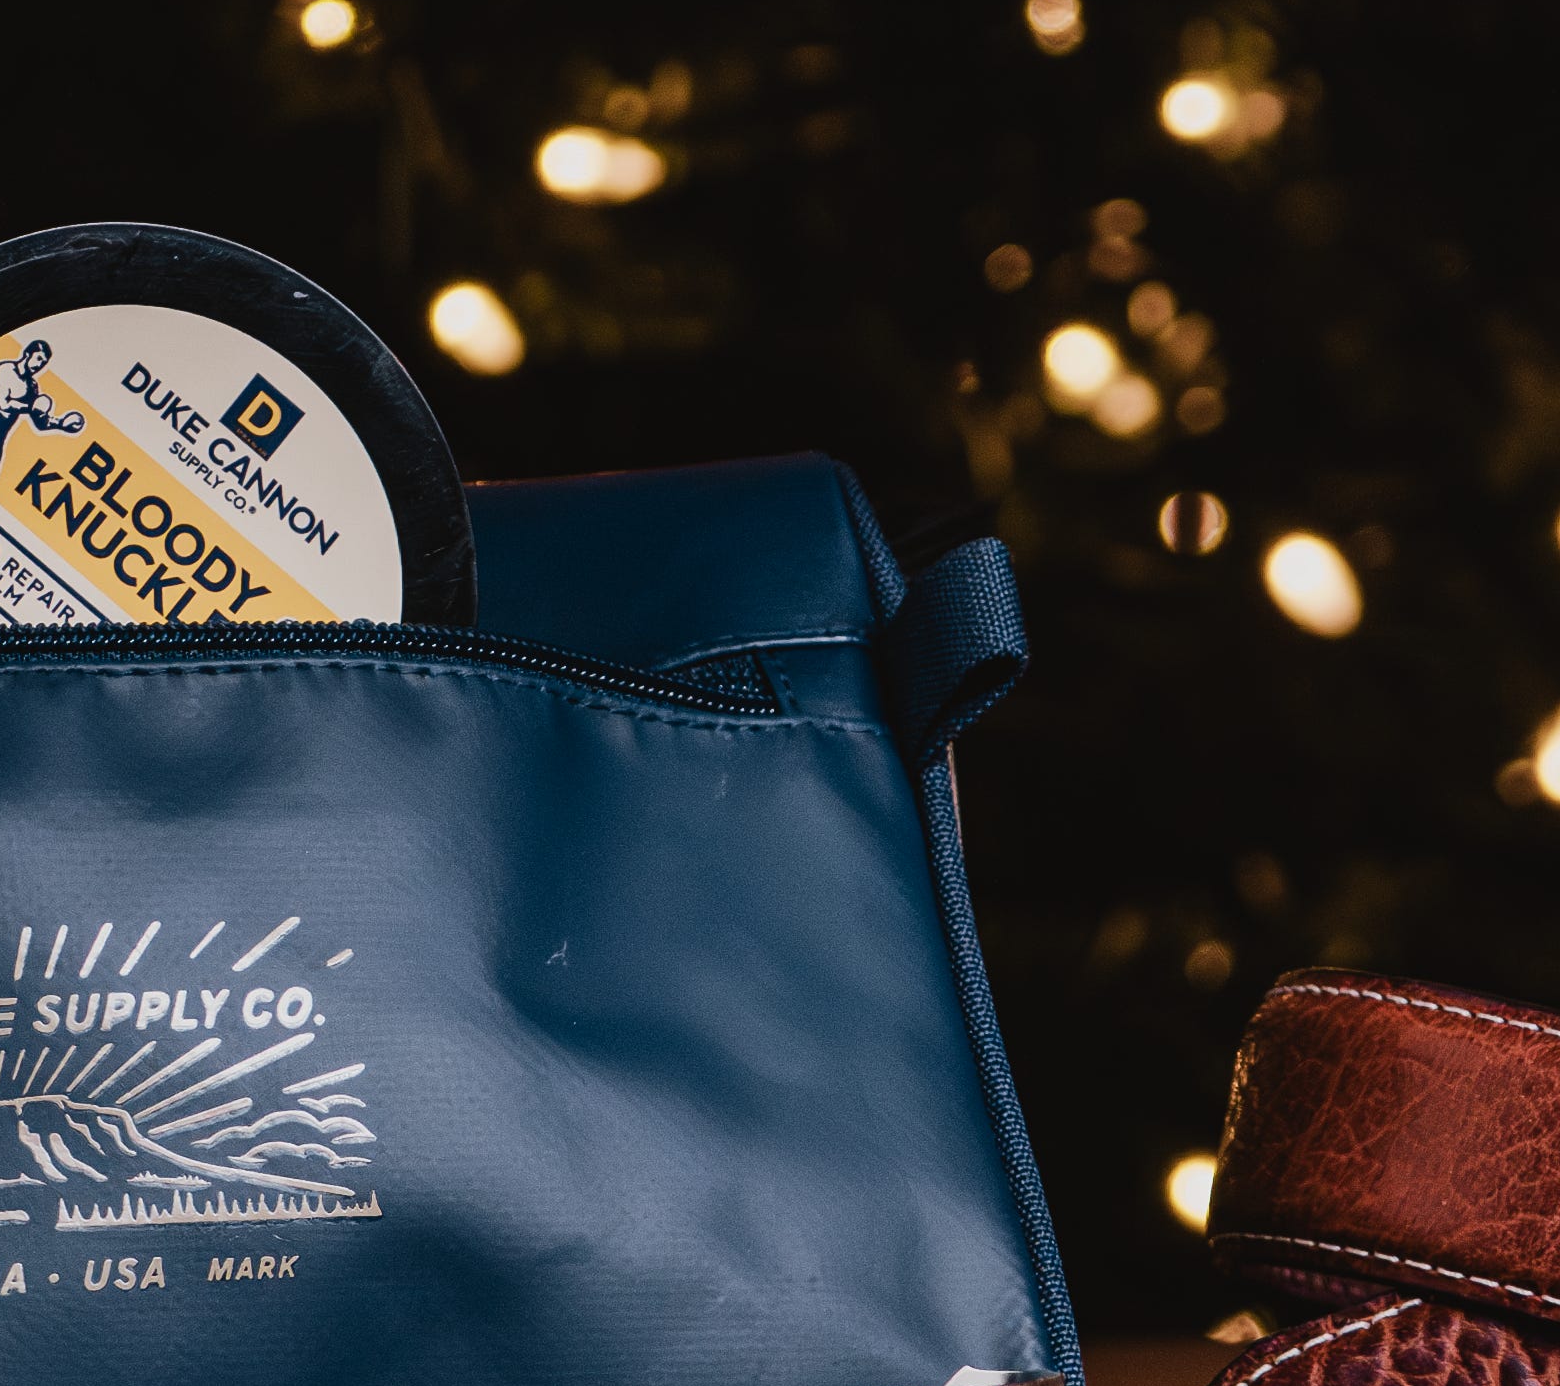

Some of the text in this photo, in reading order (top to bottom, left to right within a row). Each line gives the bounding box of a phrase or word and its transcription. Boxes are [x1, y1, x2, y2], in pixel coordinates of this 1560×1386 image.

[237, 390, 282, 437] D
[120, 361, 340, 556] DUKE CANNON
[168, 441, 225, 490] SUPPLY
[69, 441, 272, 614] BLOODY
[2, 556, 76, 623] REPAIR
[31, 986, 232, 1034] SUPPLY
[241, 985, 328, 1030] CO.
[83, 1256, 167, 1293] USA
[206, 1254, 301, 1283] MARK
